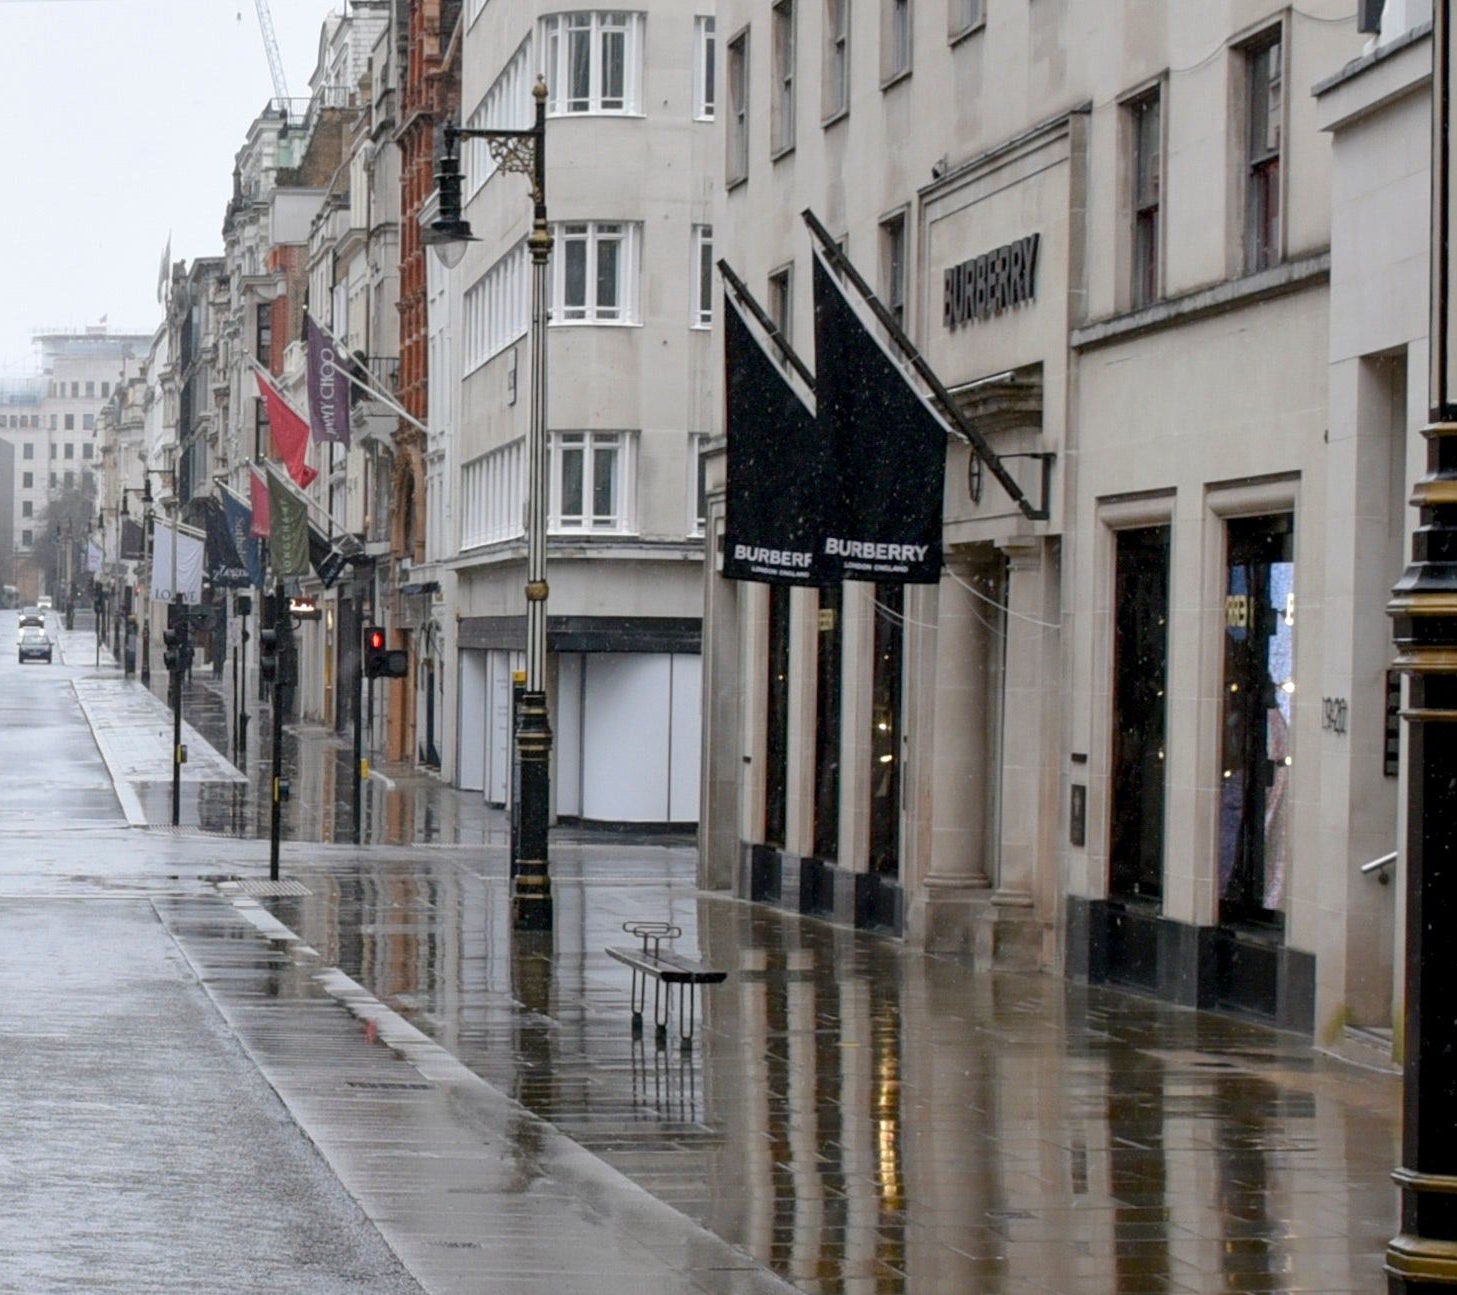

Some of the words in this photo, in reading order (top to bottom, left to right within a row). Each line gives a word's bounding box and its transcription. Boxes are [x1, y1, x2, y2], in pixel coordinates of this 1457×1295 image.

[943, 232, 1041, 327] BURBERRY
[319, 348, 336, 400] CHOO
[320, 401, 340, 440] JIMMY
[825, 537, 930, 562] BURBERRY
[843, 561, 872, 571] LONDON
[873, 564, 910, 574] ENGLAND
